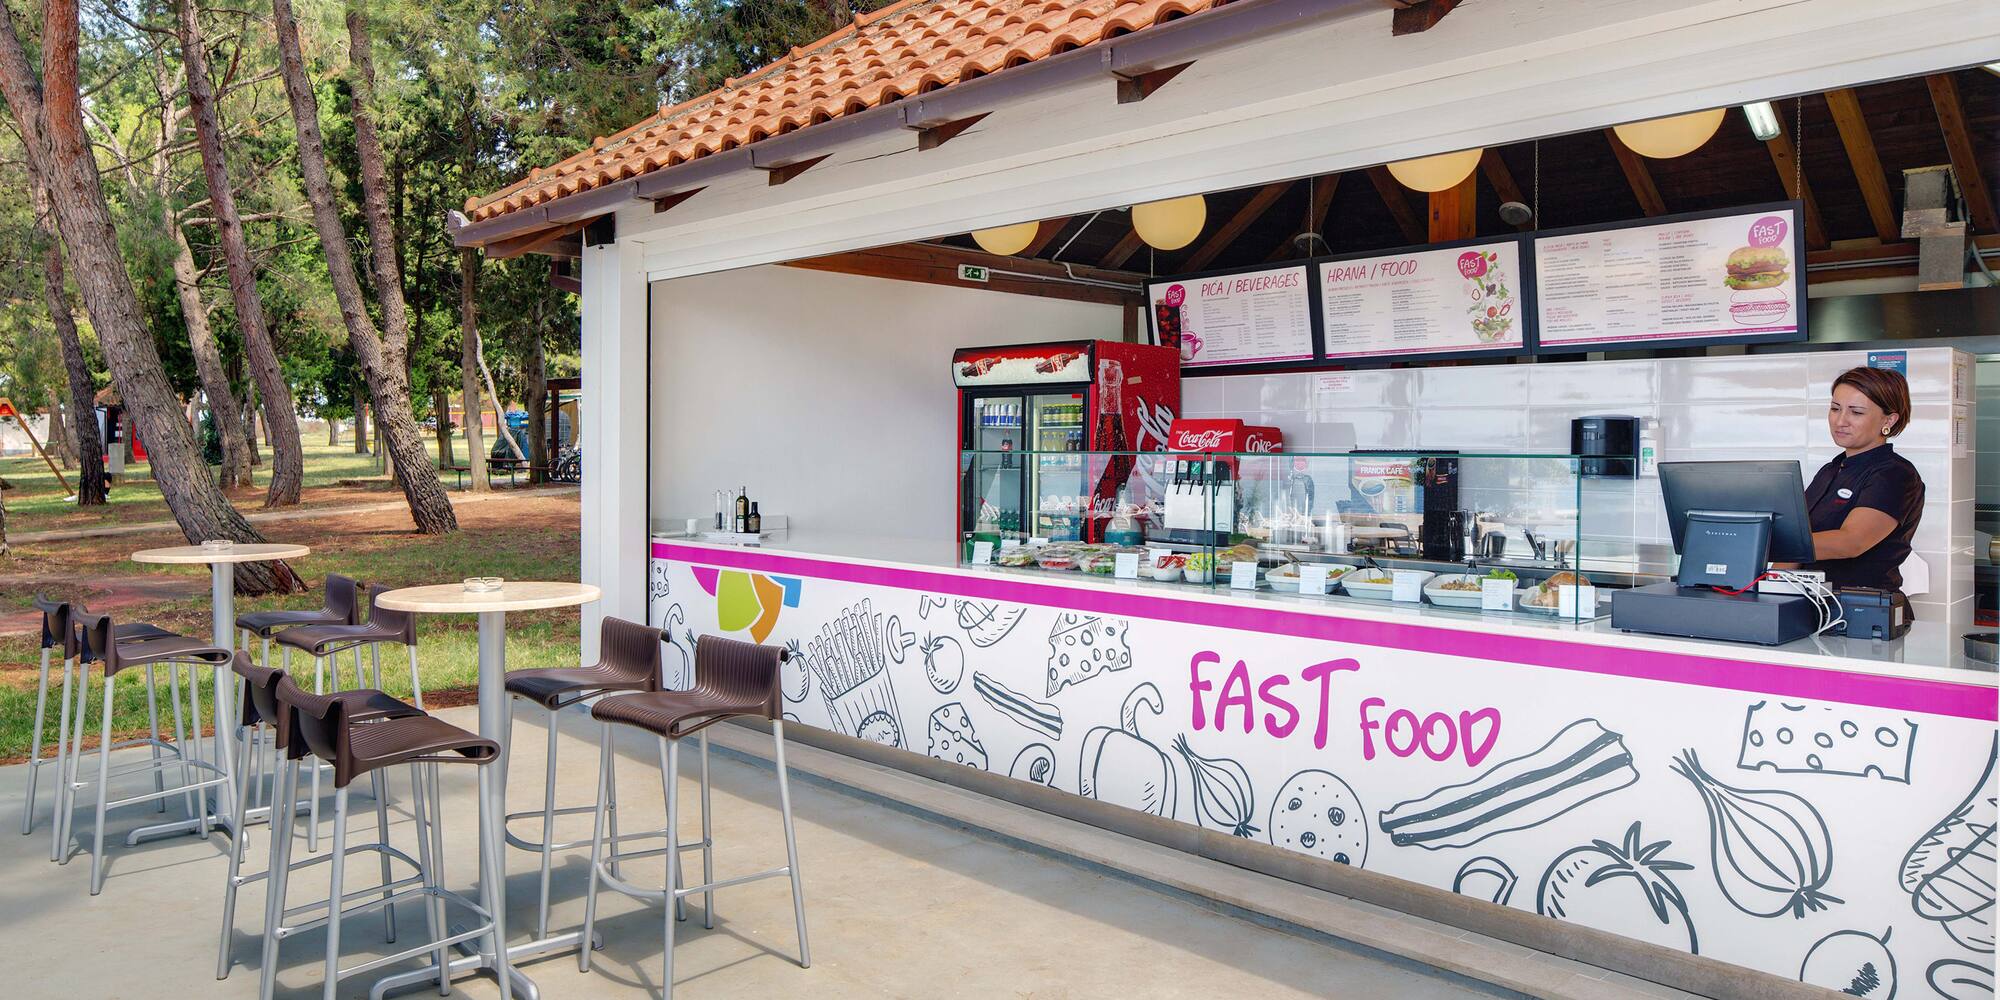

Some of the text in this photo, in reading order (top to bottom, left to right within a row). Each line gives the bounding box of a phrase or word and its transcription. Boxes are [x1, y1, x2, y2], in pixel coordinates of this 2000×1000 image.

[1753, 221, 1784, 238] FAST
[1759, 235, 1777, 244] FOOD
[1327, 265, 1366, 283] HRANA
[1381, 260, 1418, 277] FOOD
[1460, 256, 1482, 270] FAST
[1236, 272, 1299, 293] BEVERAGES
[1168, 288, 1184, 299] FAST
[1178, 430, 1223, 448] Coca-Cola
[1245, 434, 1272, 453] Coke
[1360, 466, 1385, 474] FRANCK
[1190, 650, 1501, 767] FAST FOOD
